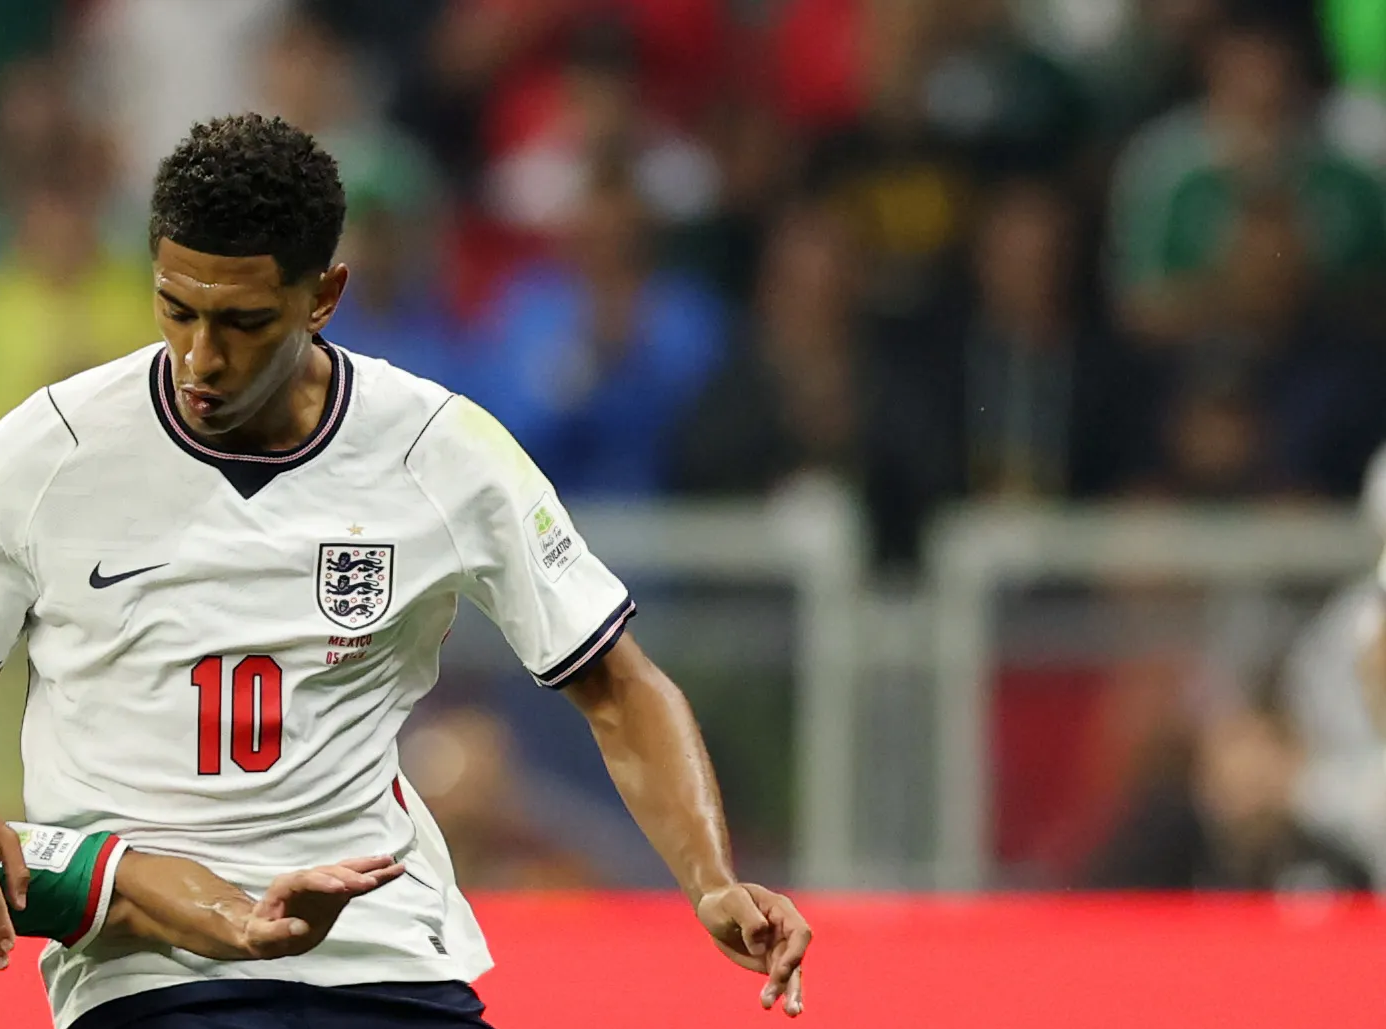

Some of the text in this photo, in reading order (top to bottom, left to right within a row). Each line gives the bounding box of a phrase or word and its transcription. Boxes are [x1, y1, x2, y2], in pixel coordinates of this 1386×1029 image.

[543, 535, 573, 569] EDUCATION
[328, 633, 373, 648] MEXICO
[191, 654, 283, 776] 10
